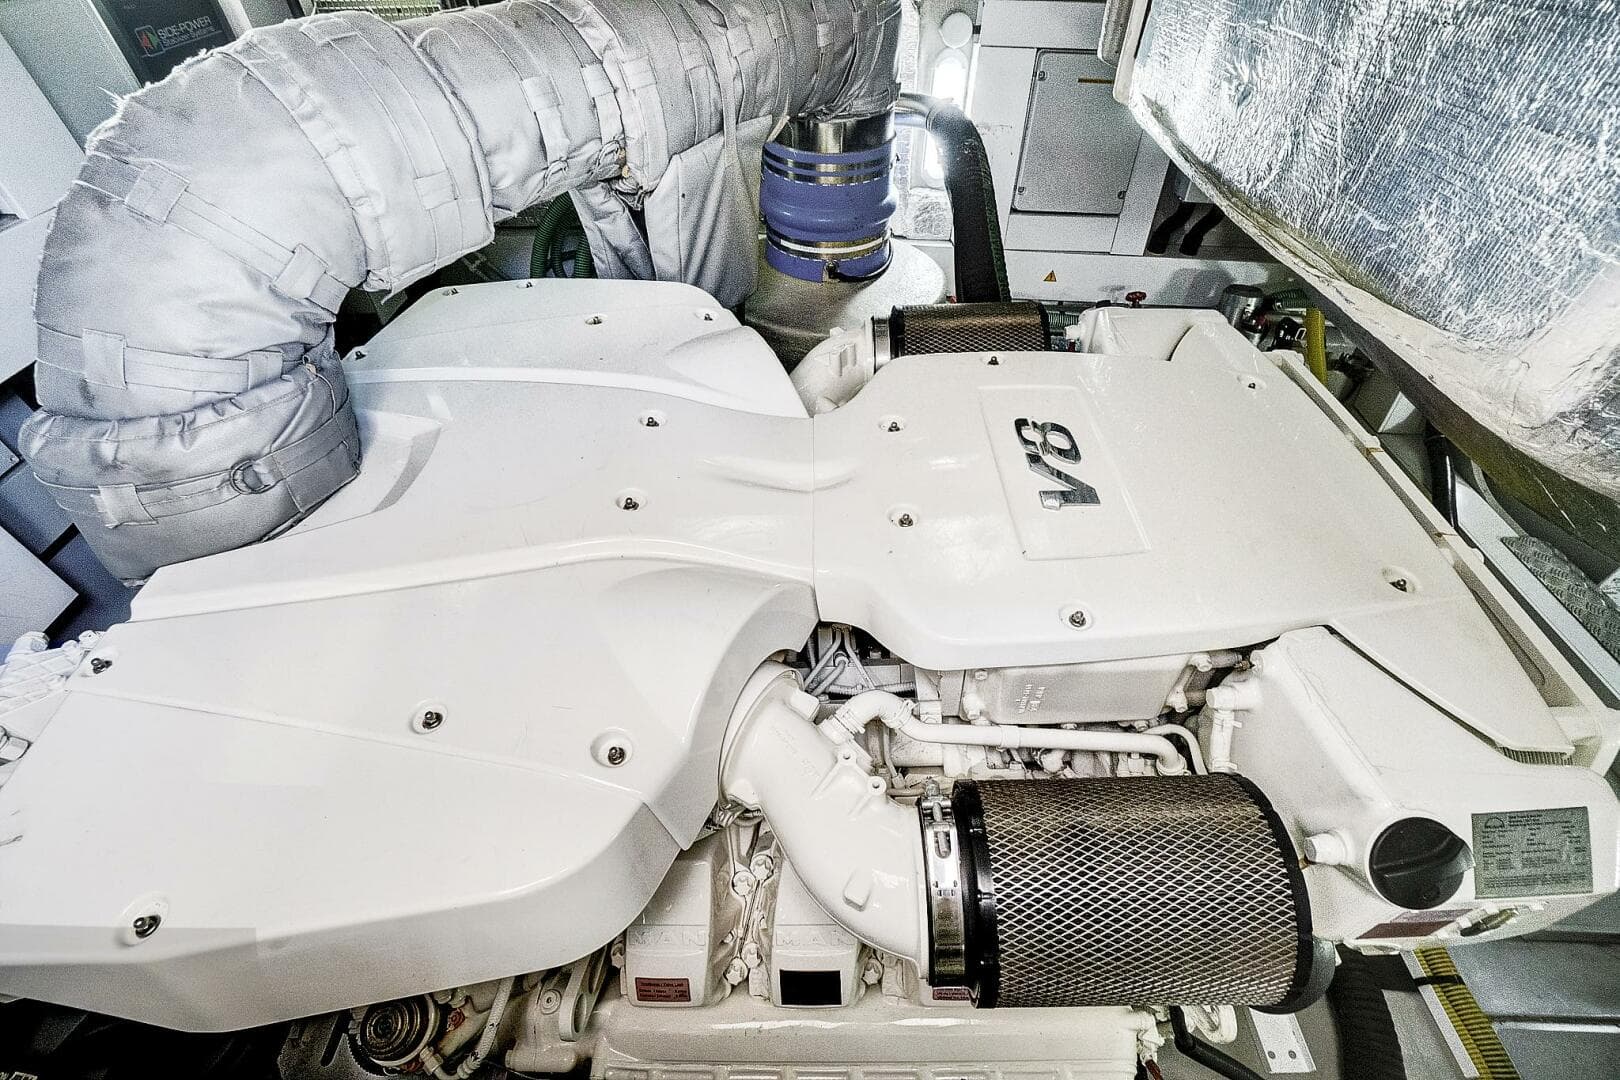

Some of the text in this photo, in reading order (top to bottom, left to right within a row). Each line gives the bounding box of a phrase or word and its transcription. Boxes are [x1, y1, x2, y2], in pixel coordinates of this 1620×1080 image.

[157, 15, 212, 40] SIDE-POWER
[1014, 417, 1101, 510] V8
[628, 927, 706, 947] MAN
[775, 927, 856, 947] MAN
